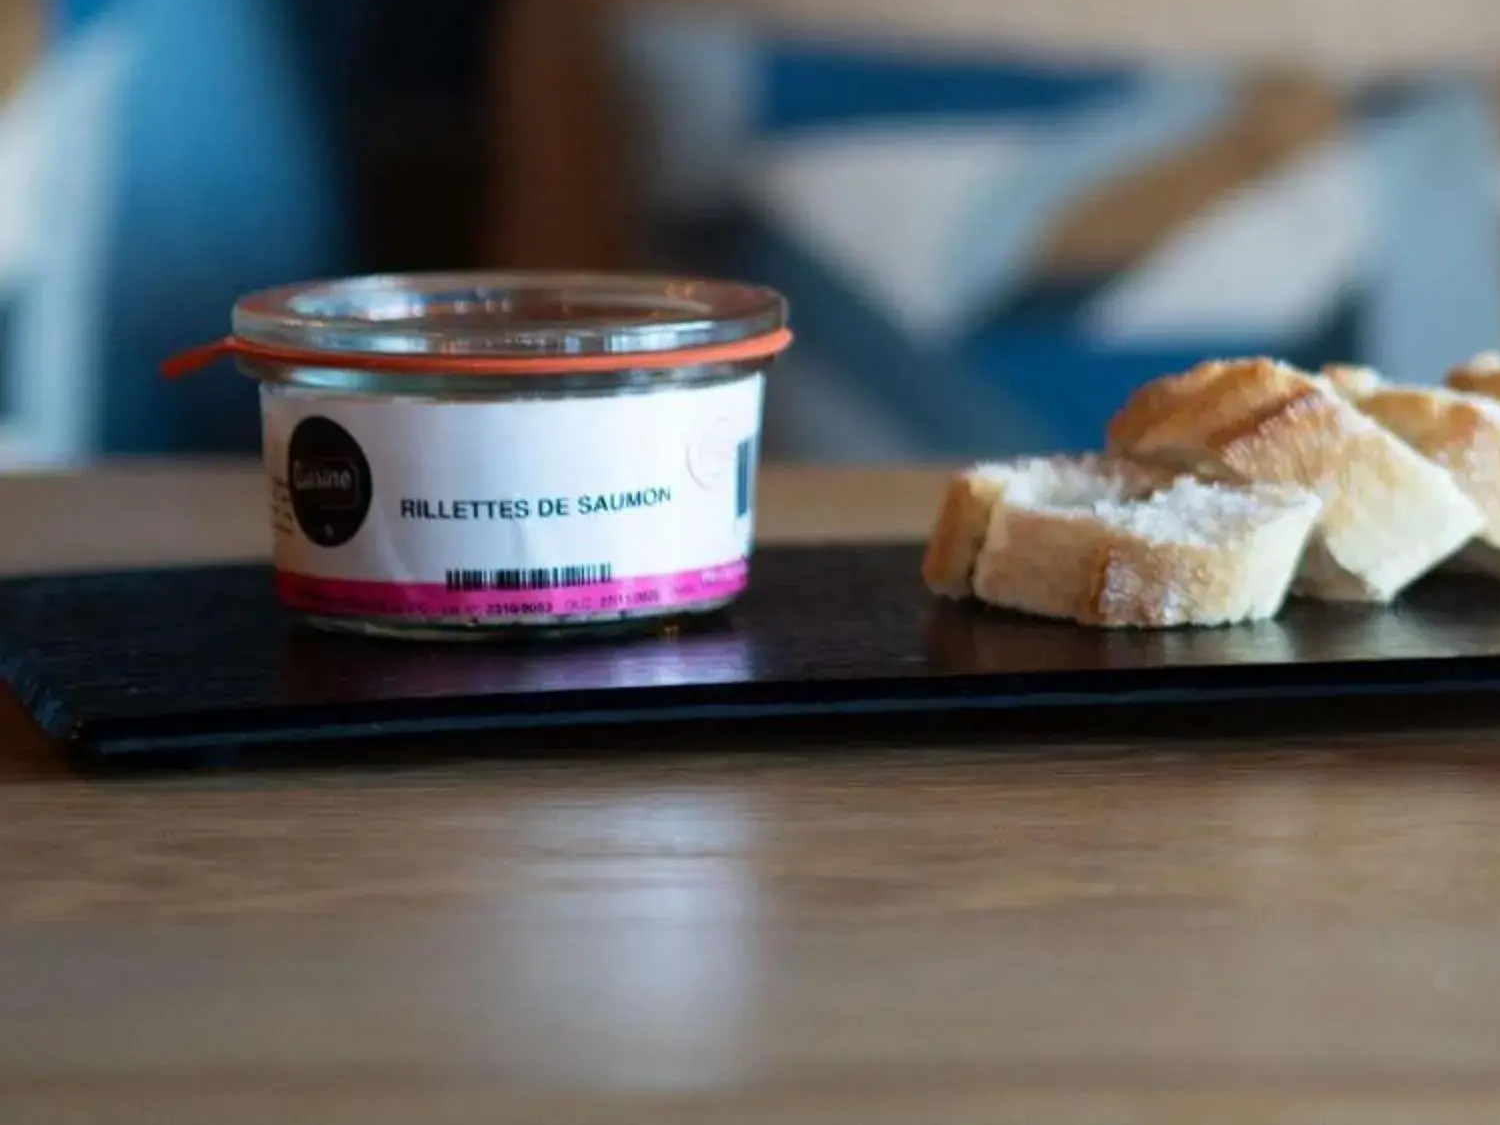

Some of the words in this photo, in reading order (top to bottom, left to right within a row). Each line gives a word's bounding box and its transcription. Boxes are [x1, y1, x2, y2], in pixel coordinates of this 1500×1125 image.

[400, 498, 530, 521] RILLETTES
[538, 496, 570, 519] DE
[577, 485, 672, 516] SAUMON
